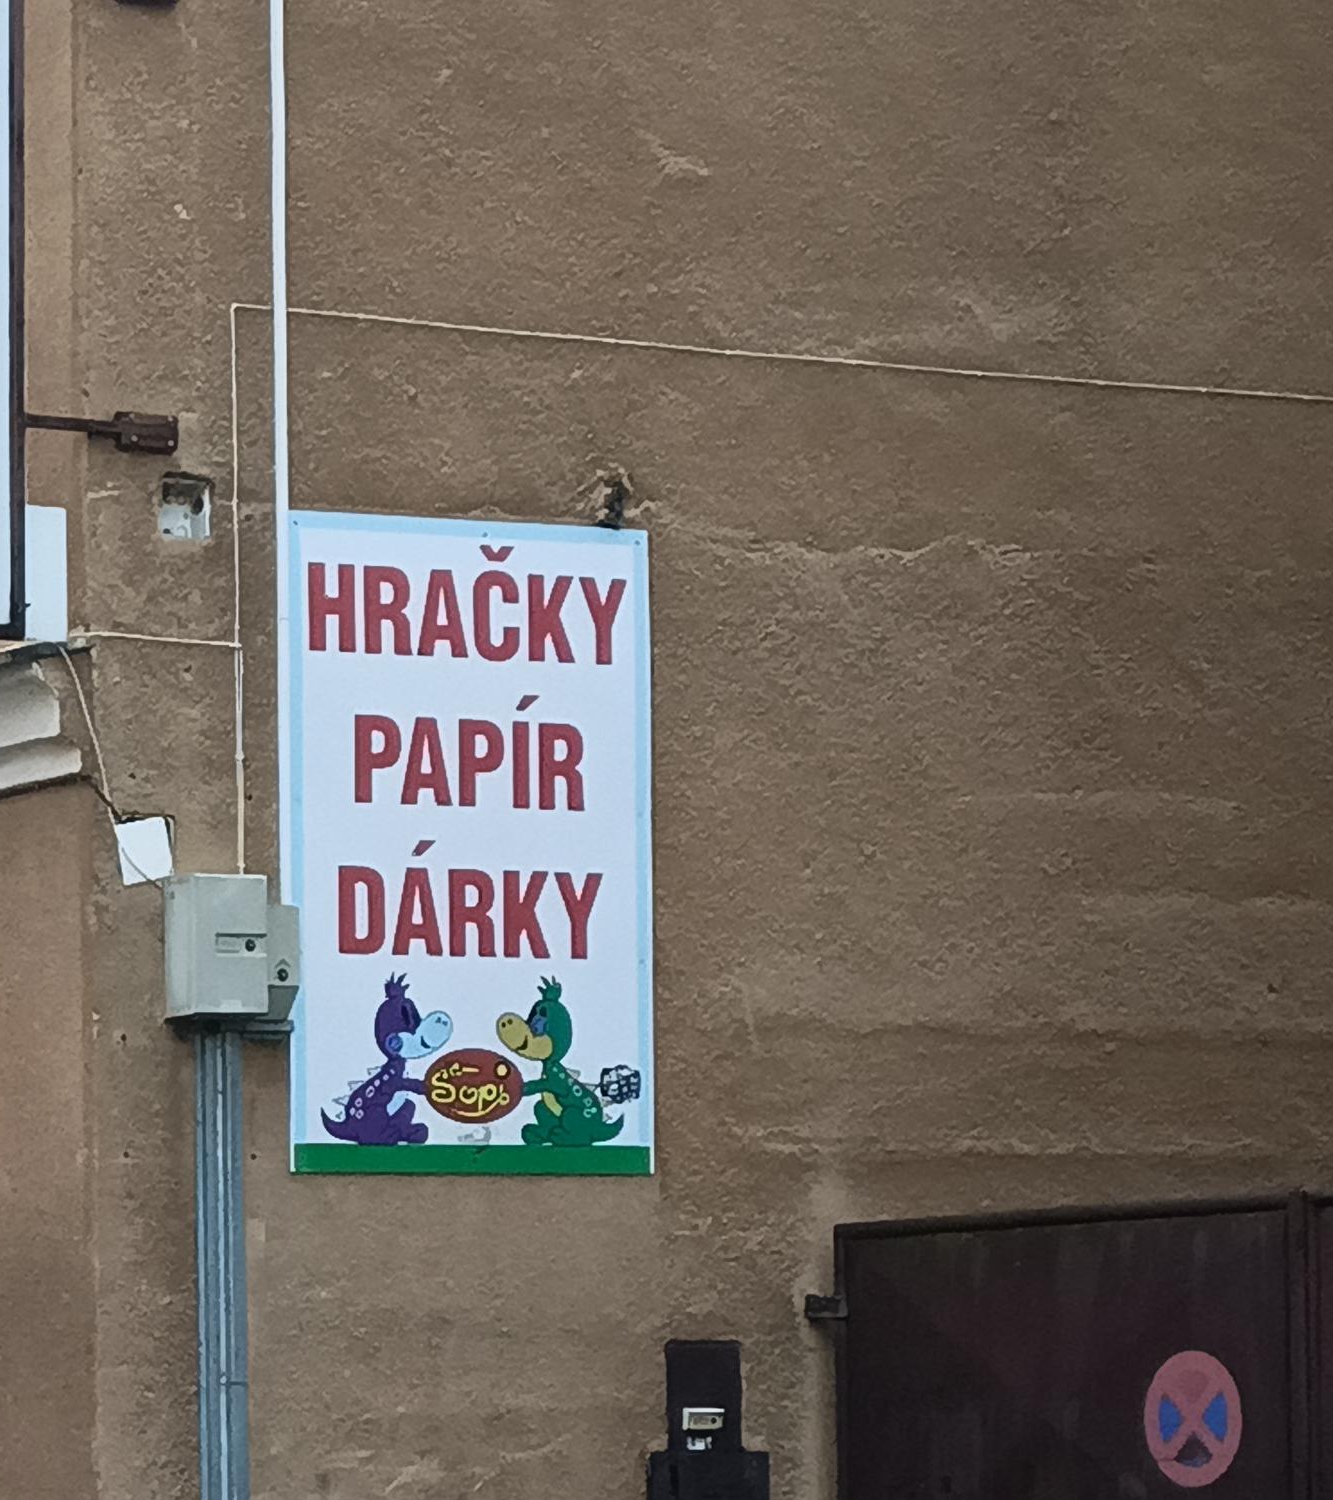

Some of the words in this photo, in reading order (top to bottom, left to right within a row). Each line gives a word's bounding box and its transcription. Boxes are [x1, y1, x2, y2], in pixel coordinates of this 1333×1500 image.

[308, 545, 627, 665] HRAČKY
[353, 695, 585, 811] PAPÍR
[337, 840, 603, 960] DÁRKY
